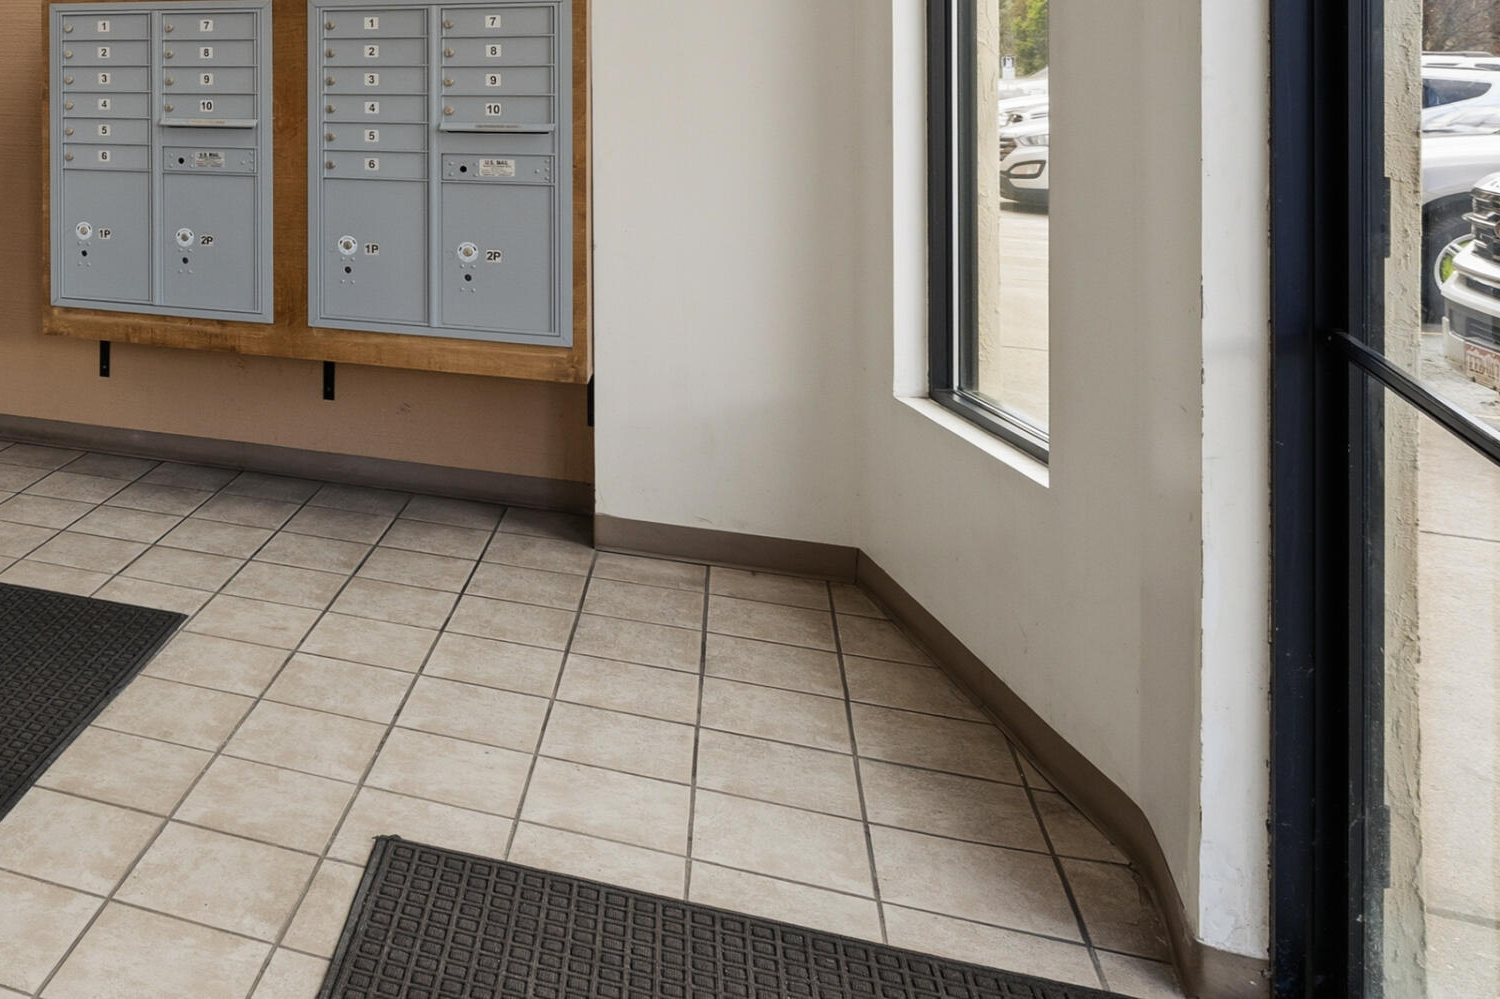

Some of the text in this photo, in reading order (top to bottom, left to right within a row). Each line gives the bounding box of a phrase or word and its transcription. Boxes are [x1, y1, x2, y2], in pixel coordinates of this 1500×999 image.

[203, 21, 210, 29] 7
[368, 19, 375, 28] 1
[489, 17, 497, 26] 7
[101, 22, 107, 31] 1
[101, 48, 107, 57] 2
[203, 48, 210, 57] 8
[368, 47, 375, 56] 2
[490, 46, 497, 56] 8
[101, 74, 107, 83] 3
[203, 74, 210, 83] 9
[368, 75, 375, 84] 3
[490, 75, 497, 85] 9
[101, 100, 107, 108] 4
[201, 102, 212, 110] 10
[368, 103, 375, 112] 4
[486, 104, 500, 114] 10
[101, 126, 107, 135] 5
[368, 131, 375, 140] 5
[101, 152, 107, 160] 6
[368, 159, 376, 169] 6
[99, 229, 111, 238] 1P
[200, 236, 214, 245] 2P
[365, 244, 379, 254] 1P
[486, 251, 501, 261] 2P
